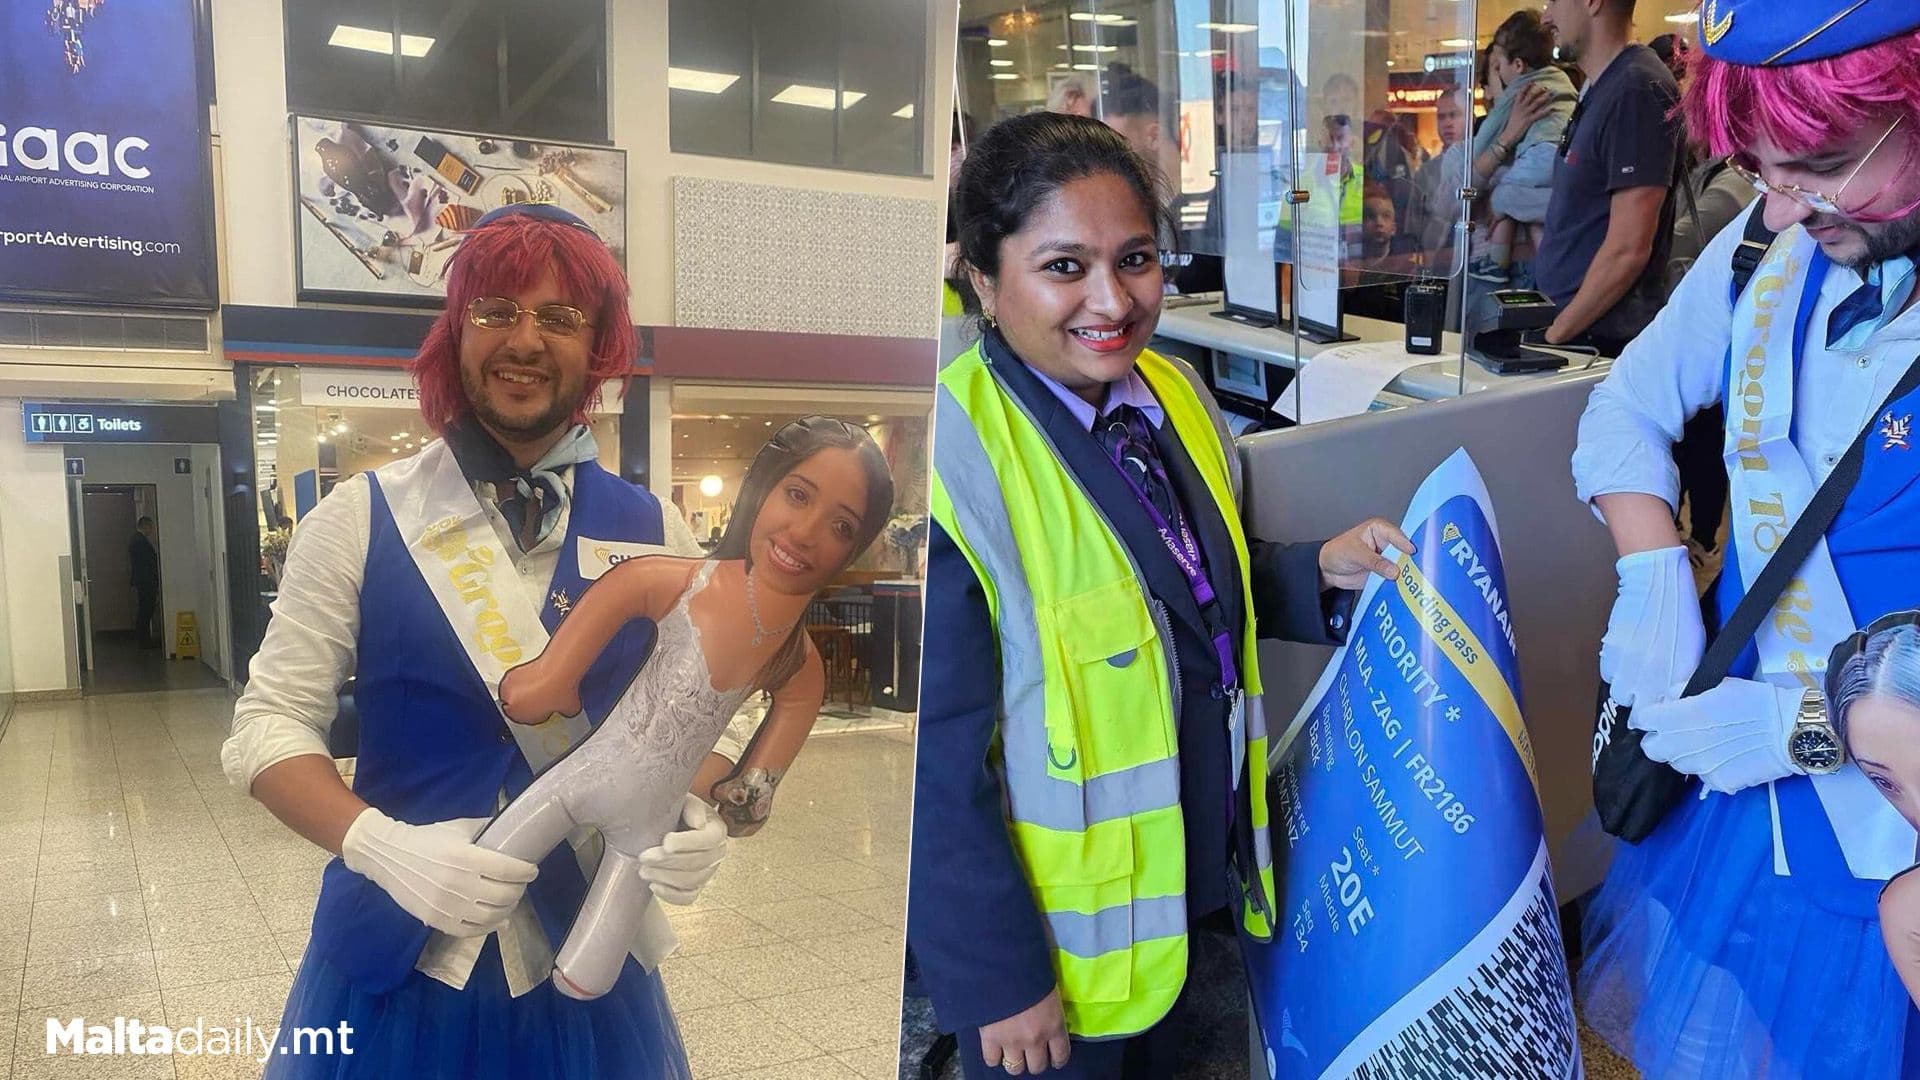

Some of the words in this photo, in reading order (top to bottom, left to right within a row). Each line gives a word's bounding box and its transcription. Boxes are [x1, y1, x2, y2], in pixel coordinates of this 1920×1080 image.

[14, 175, 47, 184] AIRPORT
[49, 178, 99, 189] ADVERTISING
[100, 183, 155, 194] CORPORATION
[1737, 268, 1792, 472] Groom
[97, 418, 142, 431] Toilets
[1749, 491, 1787, 553] To
[450, 545, 522, 664] Groo
[1401, 564, 1451, 633] Boarding
[1443, 628, 1479, 665] pass
[1449, 539, 1517, 657] RYANAIR
[1774, 577, 1813, 643] Be
[1375, 600, 1448, 707] PRIORITY
[1309, 719, 1322, 768] Back
[1322, 702, 1335, 772] Boarding
[1340, 673, 1368, 767] CHARLON
[1362, 764, 1424, 860] SAMMUT
[1355, 636, 1373, 687] MLA
[1371, 690, 1402, 740] ZAG
[1405, 753, 1475, 834] FR2186
[1352, 825, 1374, 868] Seat
[1302, 898, 1314, 934] Seq
[1319, 873, 1340, 933] Middle
[1331, 846, 1375, 936] 20E
[1294, 913, 1309, 952] 134
